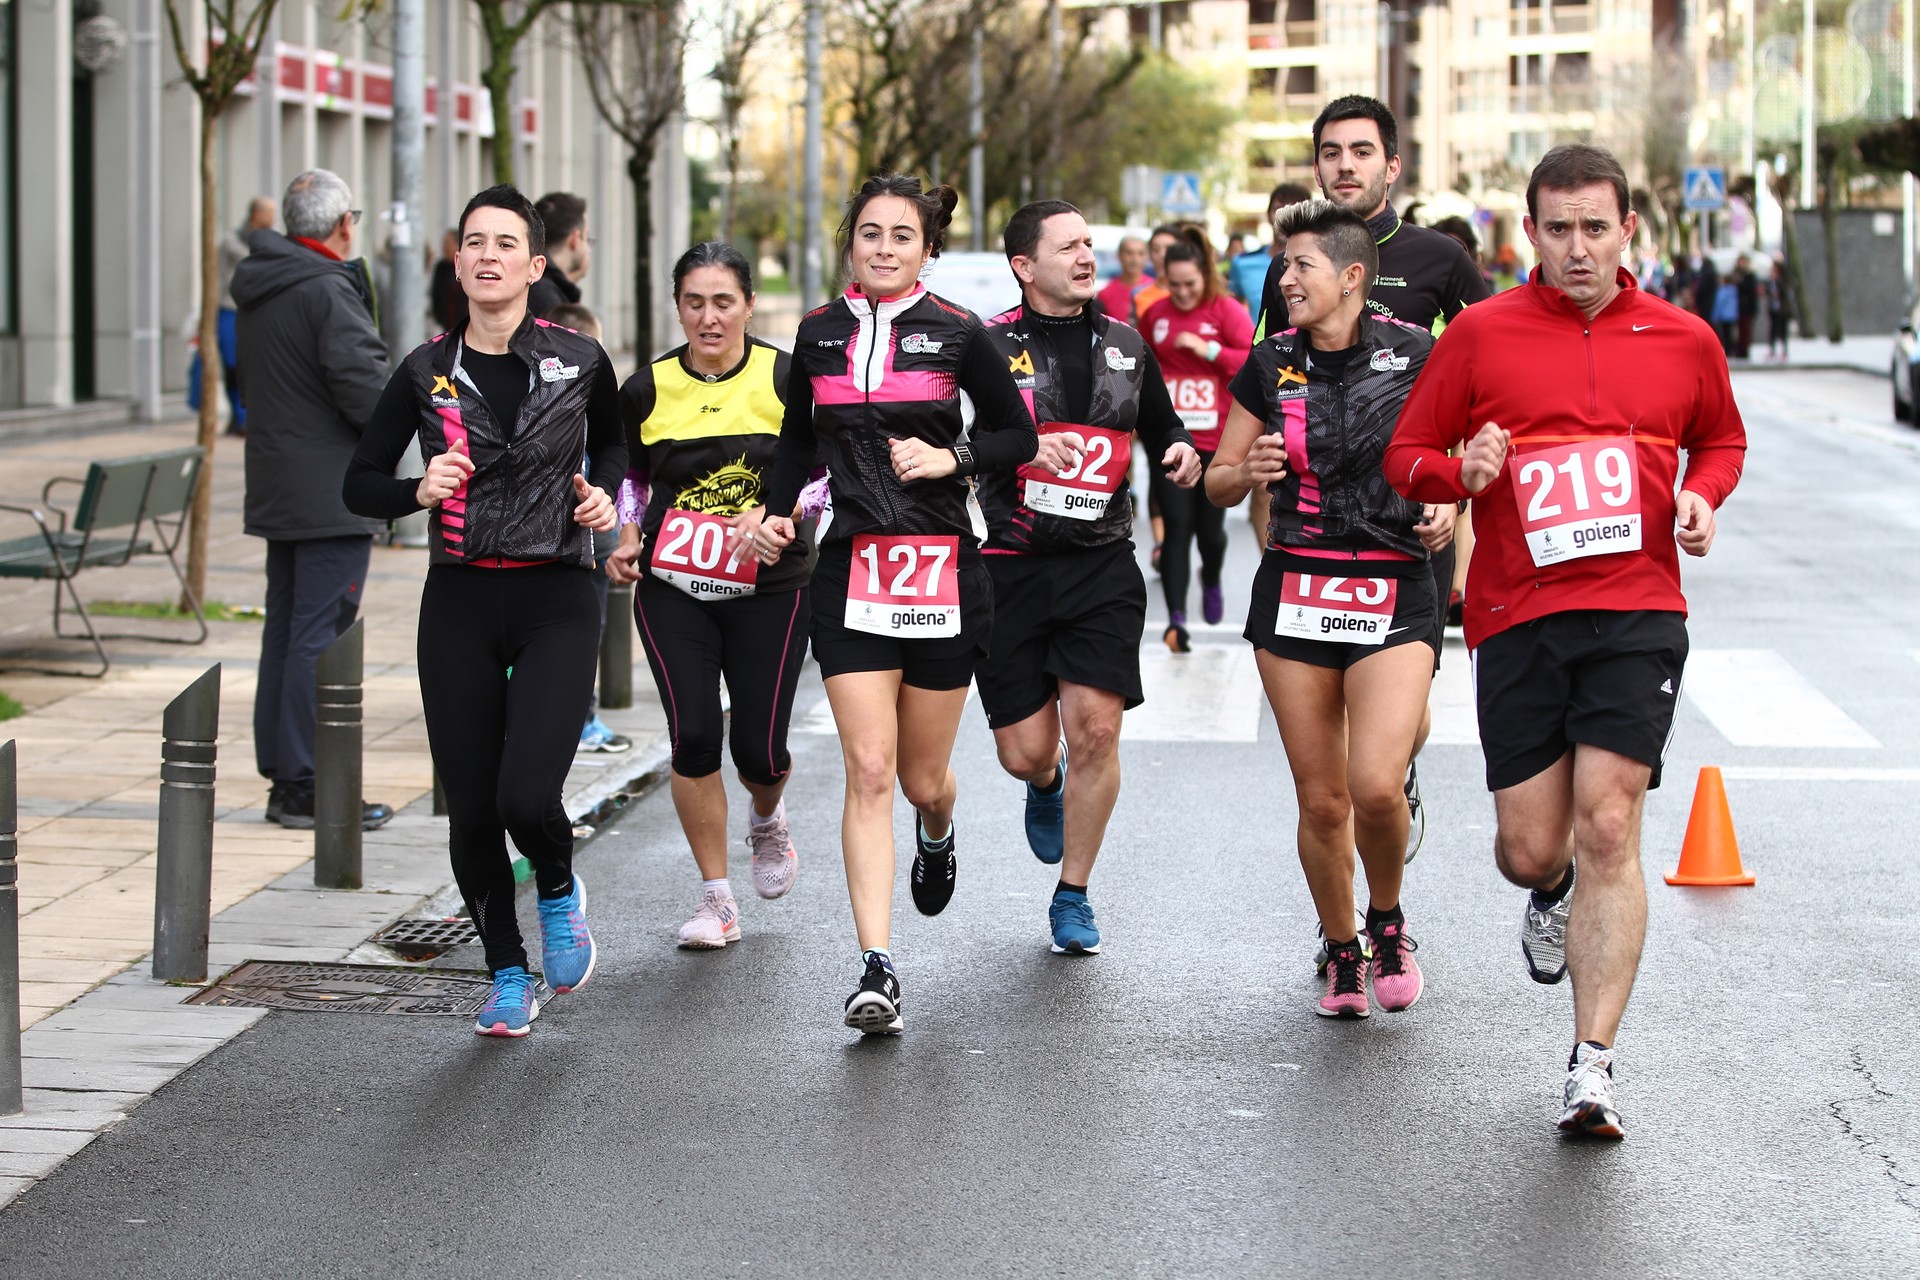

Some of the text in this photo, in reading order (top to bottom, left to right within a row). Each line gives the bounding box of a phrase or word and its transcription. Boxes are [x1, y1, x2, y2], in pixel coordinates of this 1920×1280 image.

[1165, 378, 1215, 410] 163
[1519, 447, 1633, 523] 219
[658, 516, 747, 575] 207
[860, 543, 951, 597] 127
